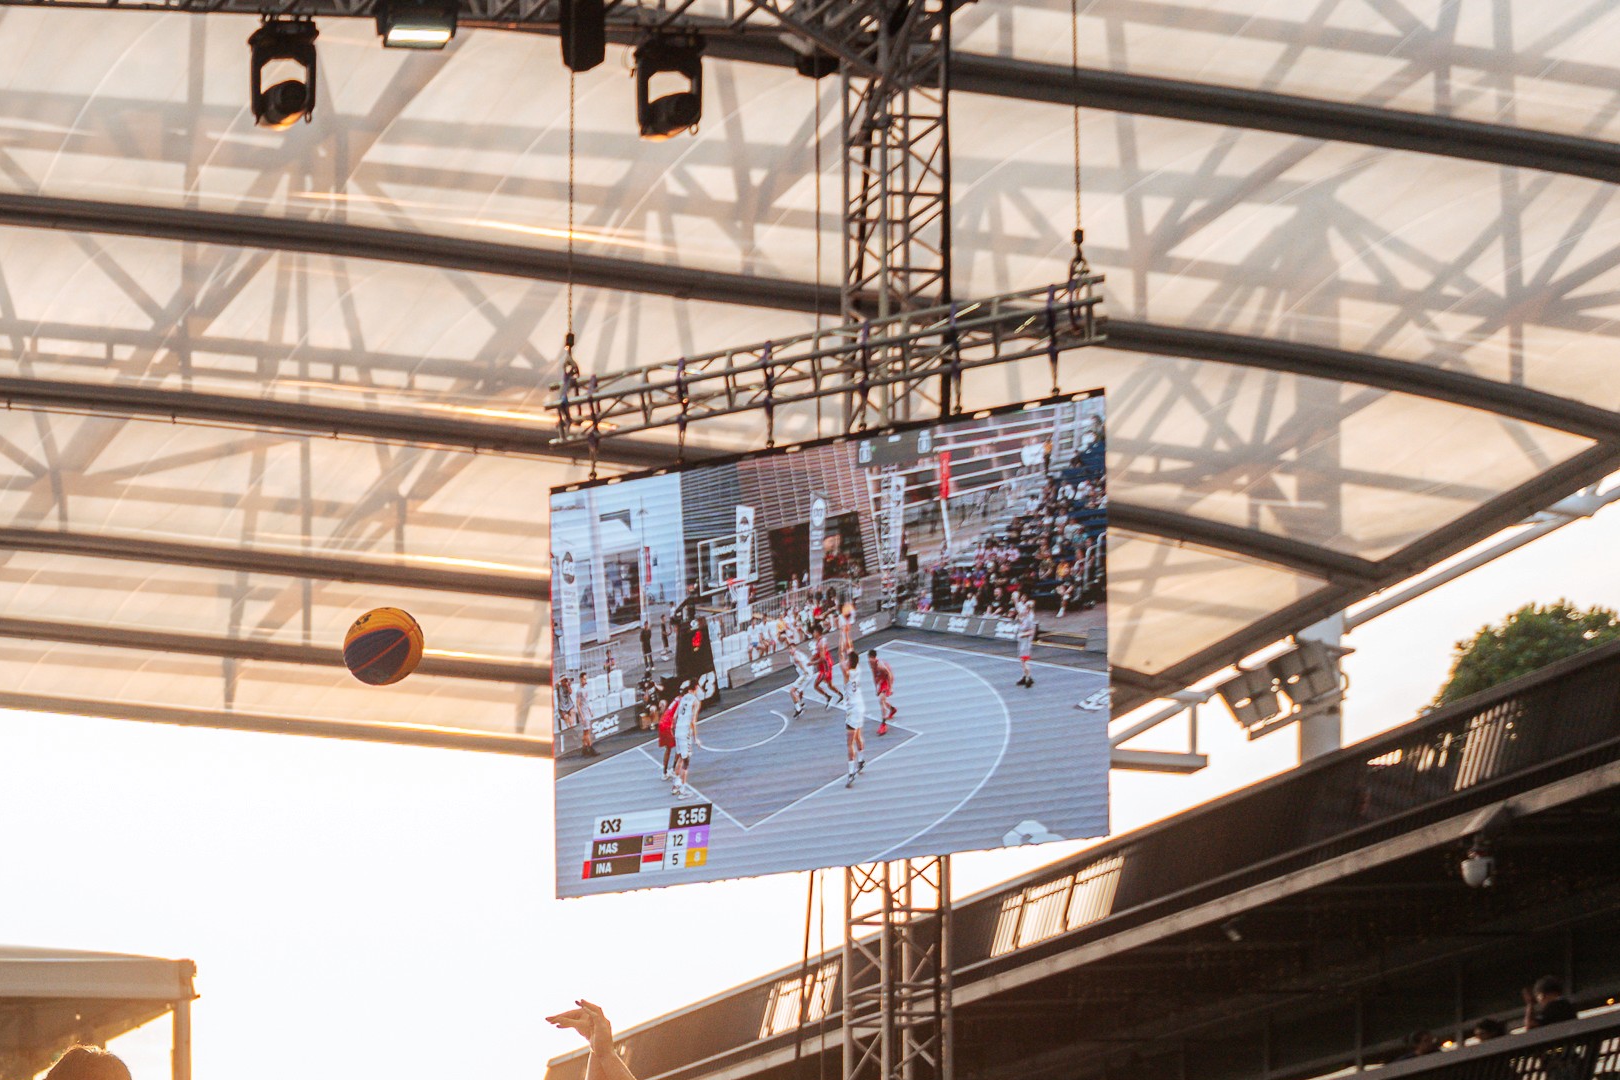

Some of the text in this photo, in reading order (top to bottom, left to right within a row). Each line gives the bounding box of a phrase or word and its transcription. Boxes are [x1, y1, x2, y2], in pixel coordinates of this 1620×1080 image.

[677, 808, 707, 825] 3:56
[598, 842, 618, 855] MAS
[672, 834, 683, 846] 12
[596, 862, 612, 874] INA
[672, 854, 678, 865] 5
